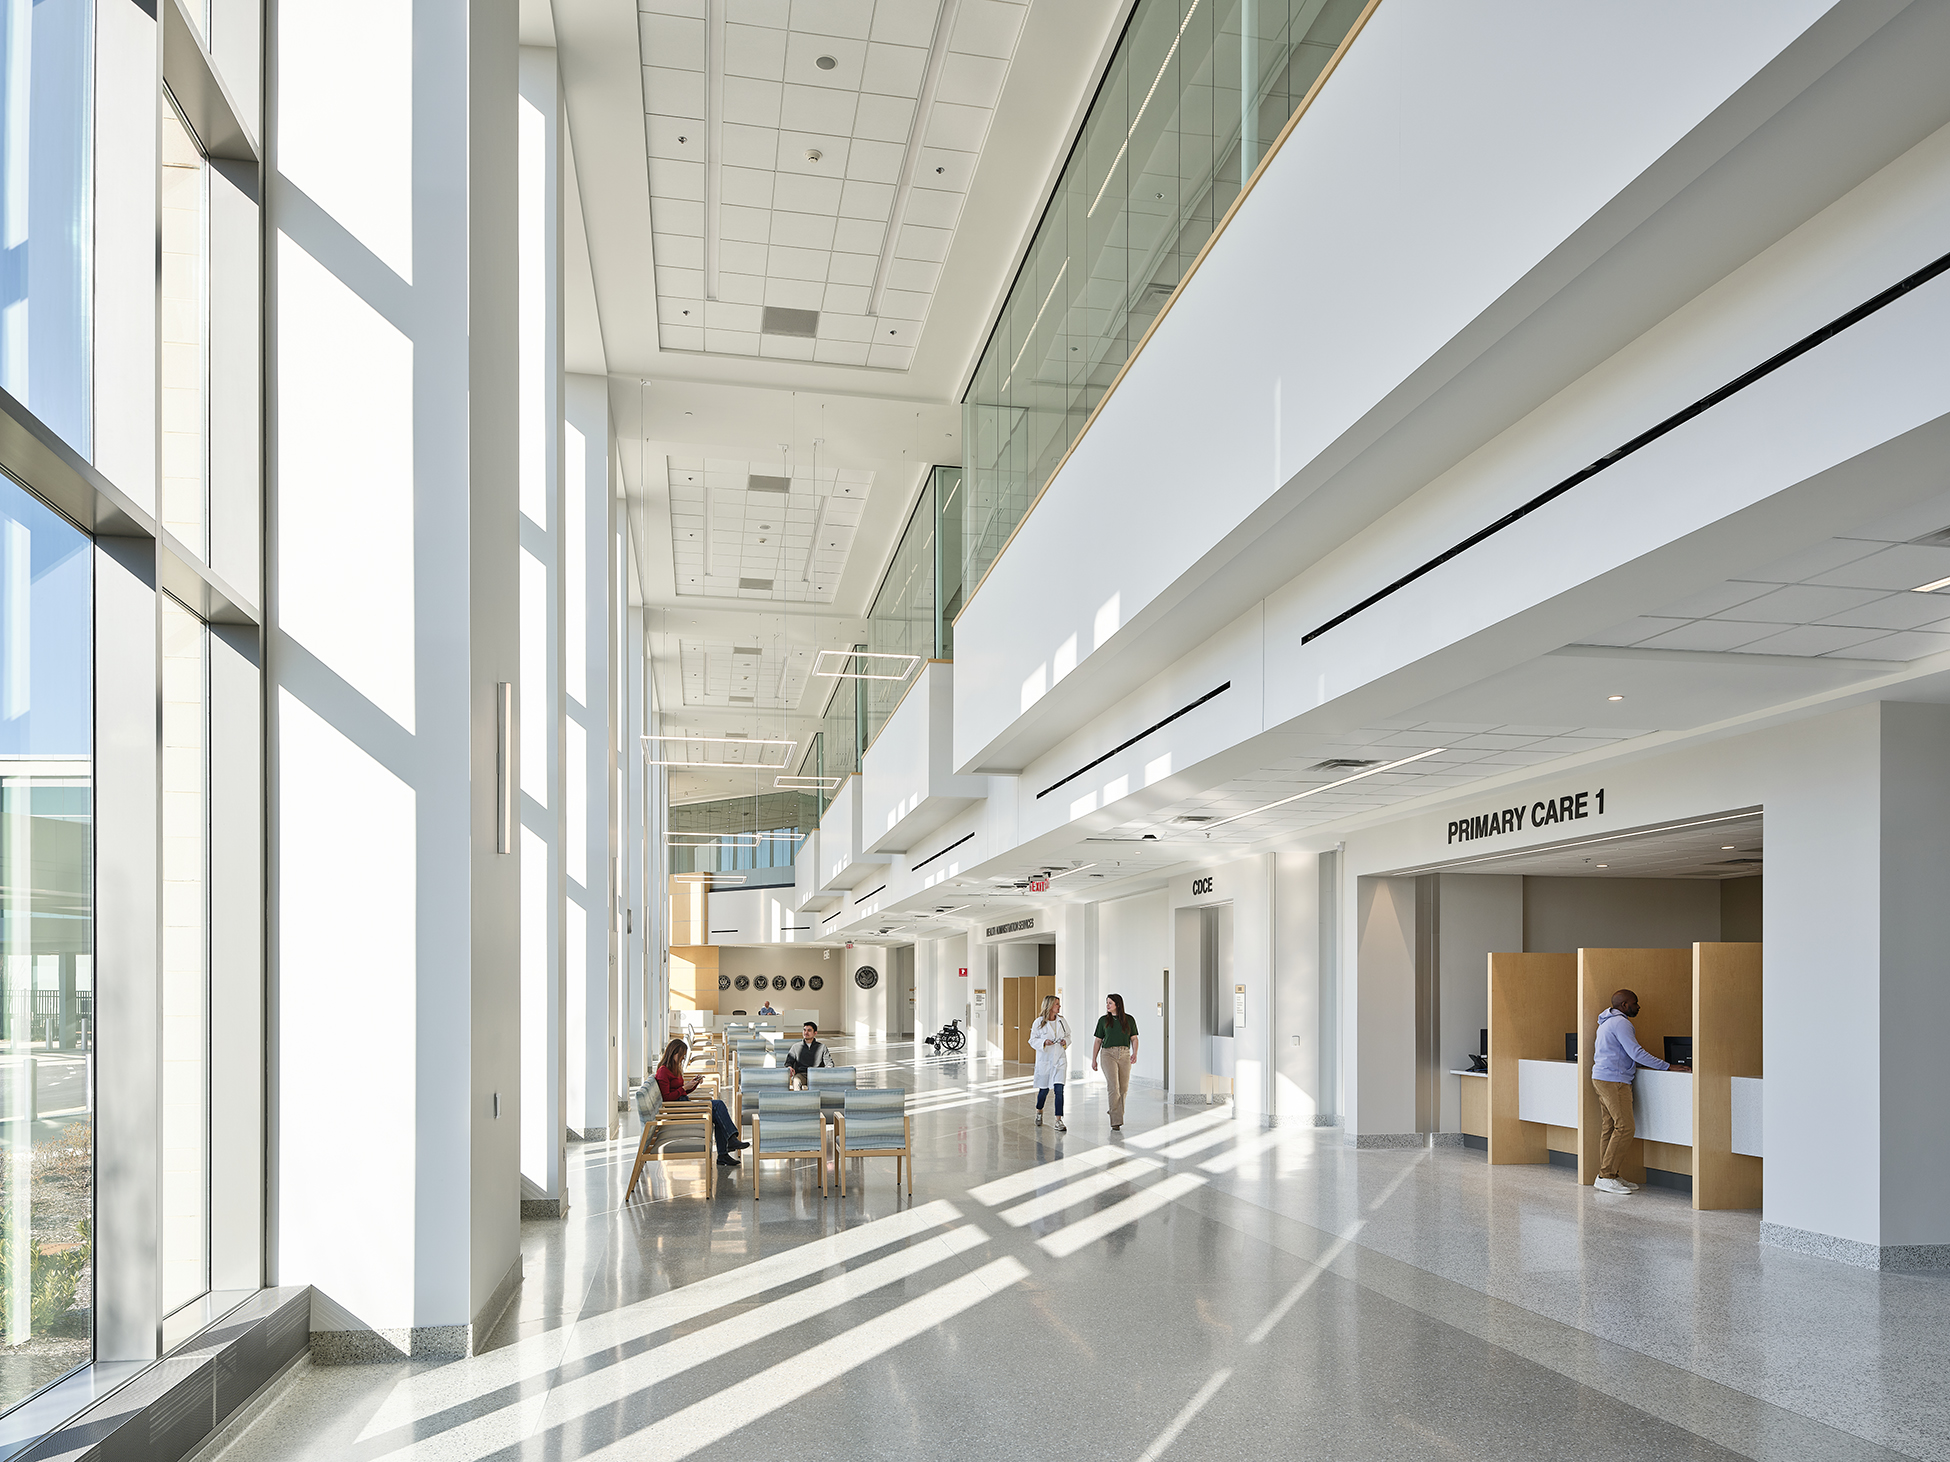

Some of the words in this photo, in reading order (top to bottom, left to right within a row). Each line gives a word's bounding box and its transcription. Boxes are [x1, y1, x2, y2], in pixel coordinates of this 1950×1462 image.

[1448, 805, 1527, 844] PRIMARY
[1531, 791, 1589, 828] CARE
[1595, 788, 1605, 815] 1
[1032, 881, 1045, 892] EXIT
[1192, 876, 1213, 896] CDCE
